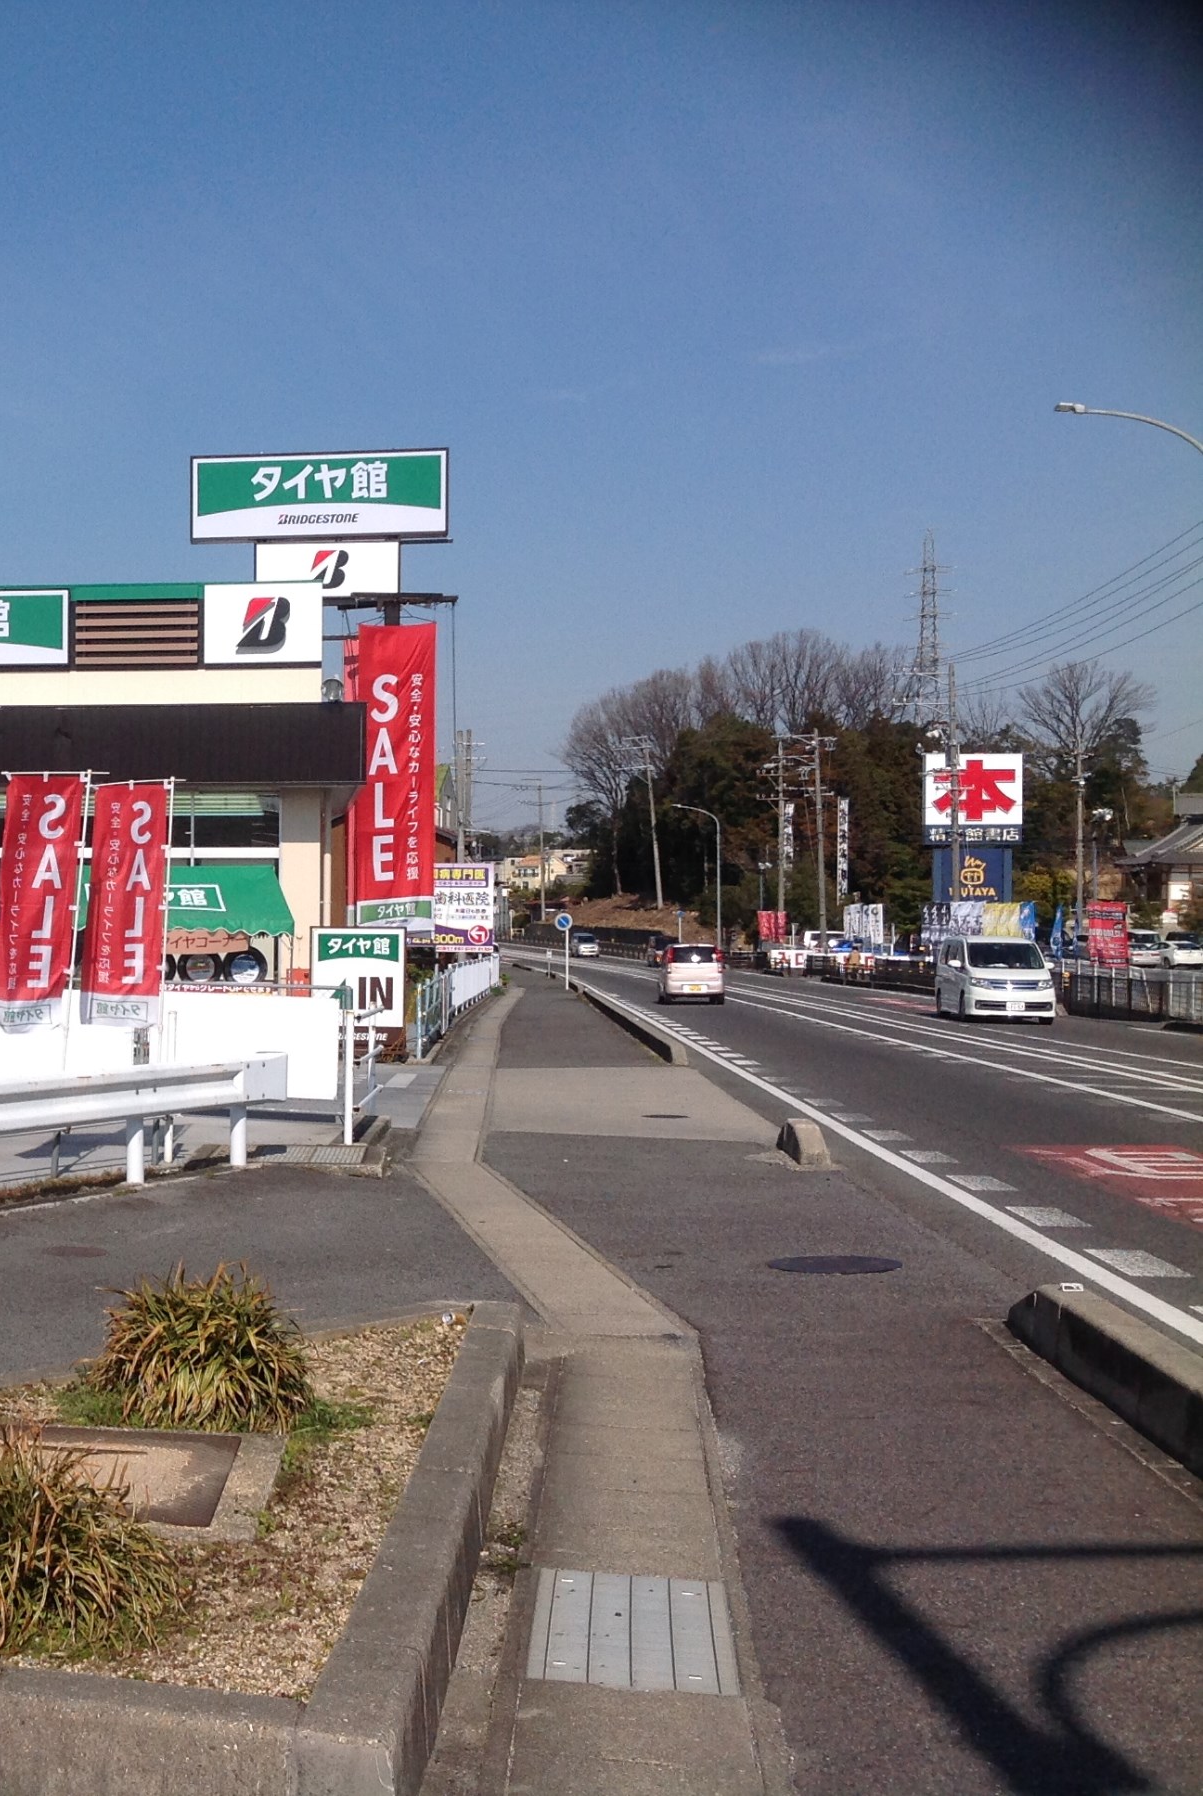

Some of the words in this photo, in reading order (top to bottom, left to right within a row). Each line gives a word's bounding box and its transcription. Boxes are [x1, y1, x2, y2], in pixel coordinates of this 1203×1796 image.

[250, 460, 389, 502] タイヤ館
[277, 512, 360, 526] BRIDGESTONE
[368, 673, 398, 882] SALE
[405, 673, 424, 881] 安全・安心なカーライフを応援
[932, 760, 1018, 822] 本
[949, 887, 996, 897] TUTAYA
[377, 902, 416, 918] タイヤ館
[327, 937, 391, 955] タイヤ館
[358, 976, 393, 1010] IN
